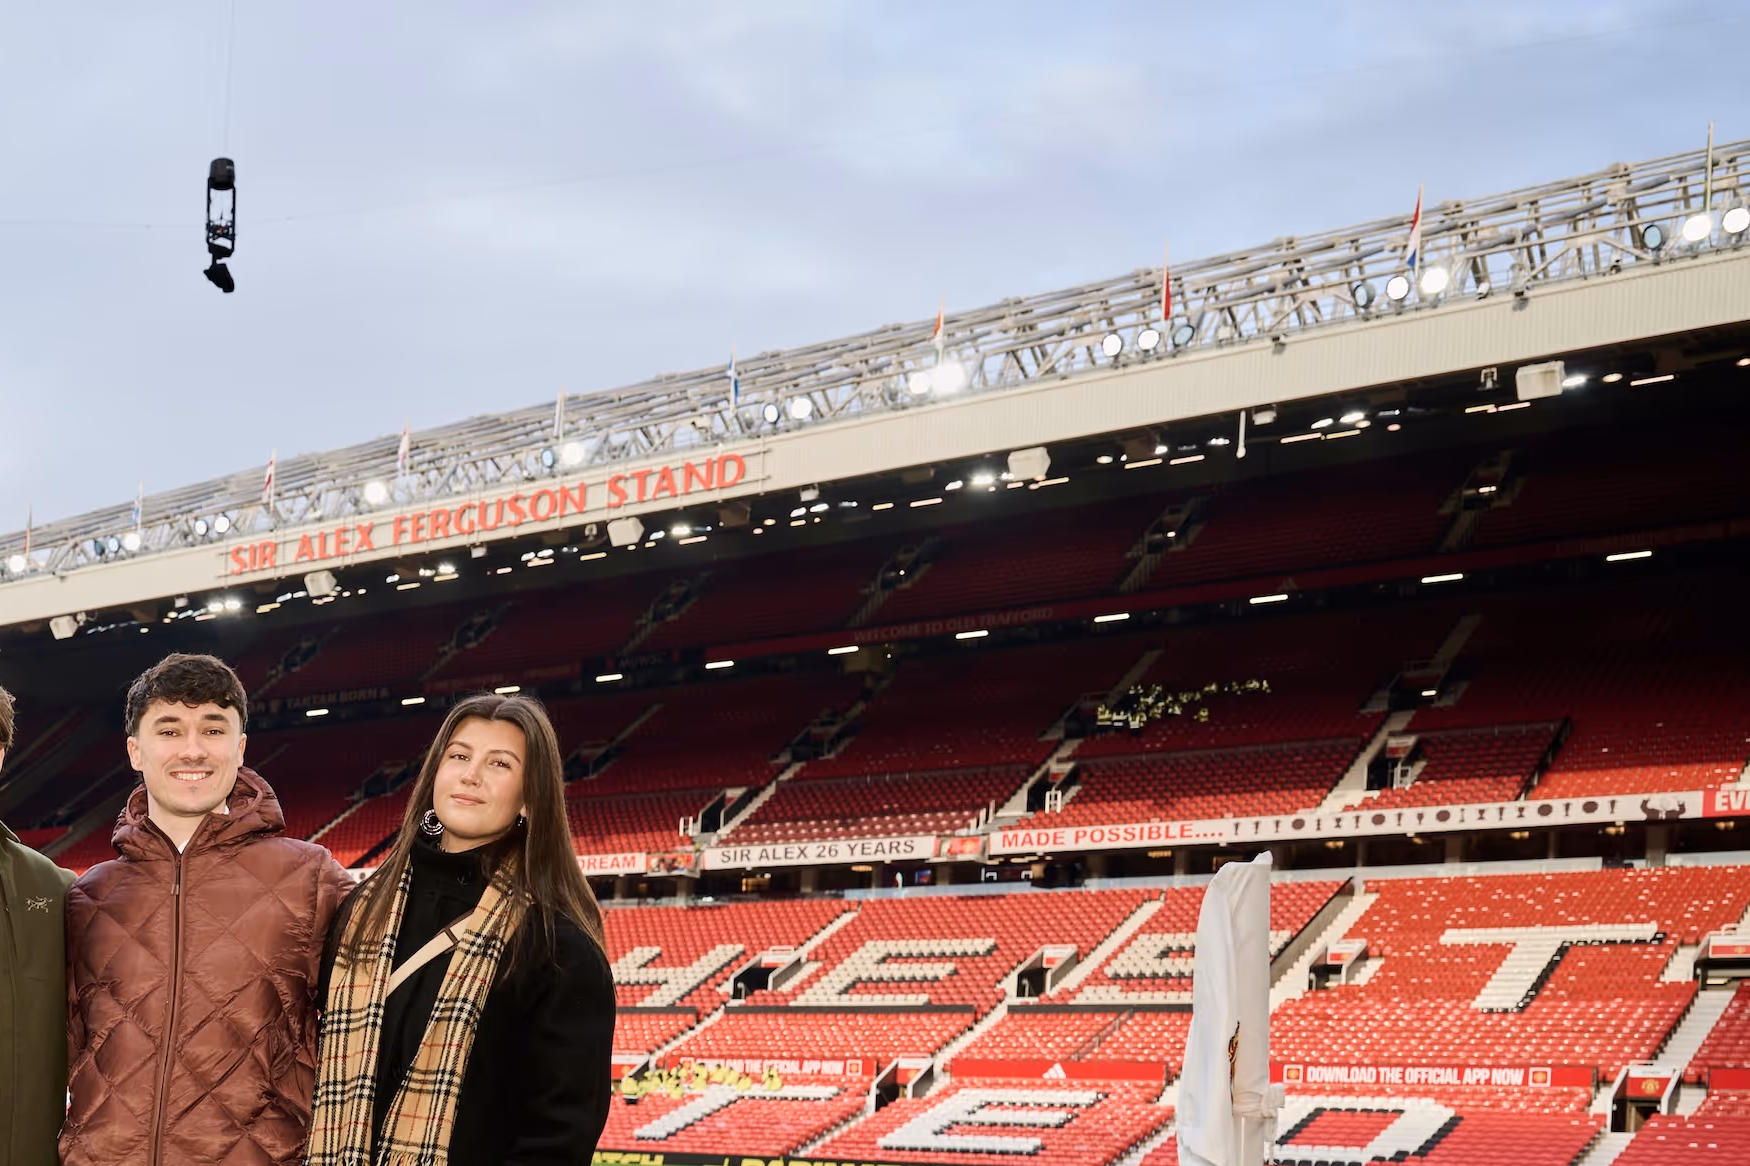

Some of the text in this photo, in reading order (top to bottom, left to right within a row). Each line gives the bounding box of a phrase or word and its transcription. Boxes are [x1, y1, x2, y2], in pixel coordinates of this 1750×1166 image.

[229, 452, 747, 576] SIR ALEX FERGUSON STAND
[1002, 830, 1065, 848] MADE
[720, 838, 916, 864] SIR ALEX 26 YEARS
[745, 1060, 762, 1074] THE
[802, 1061, 821, 1075] APP
[821, 1061, 845, 1076] NOW
[1307, 1066, 1524, 1085] DOWNLOAD THE OFFICIAL APP NOW
